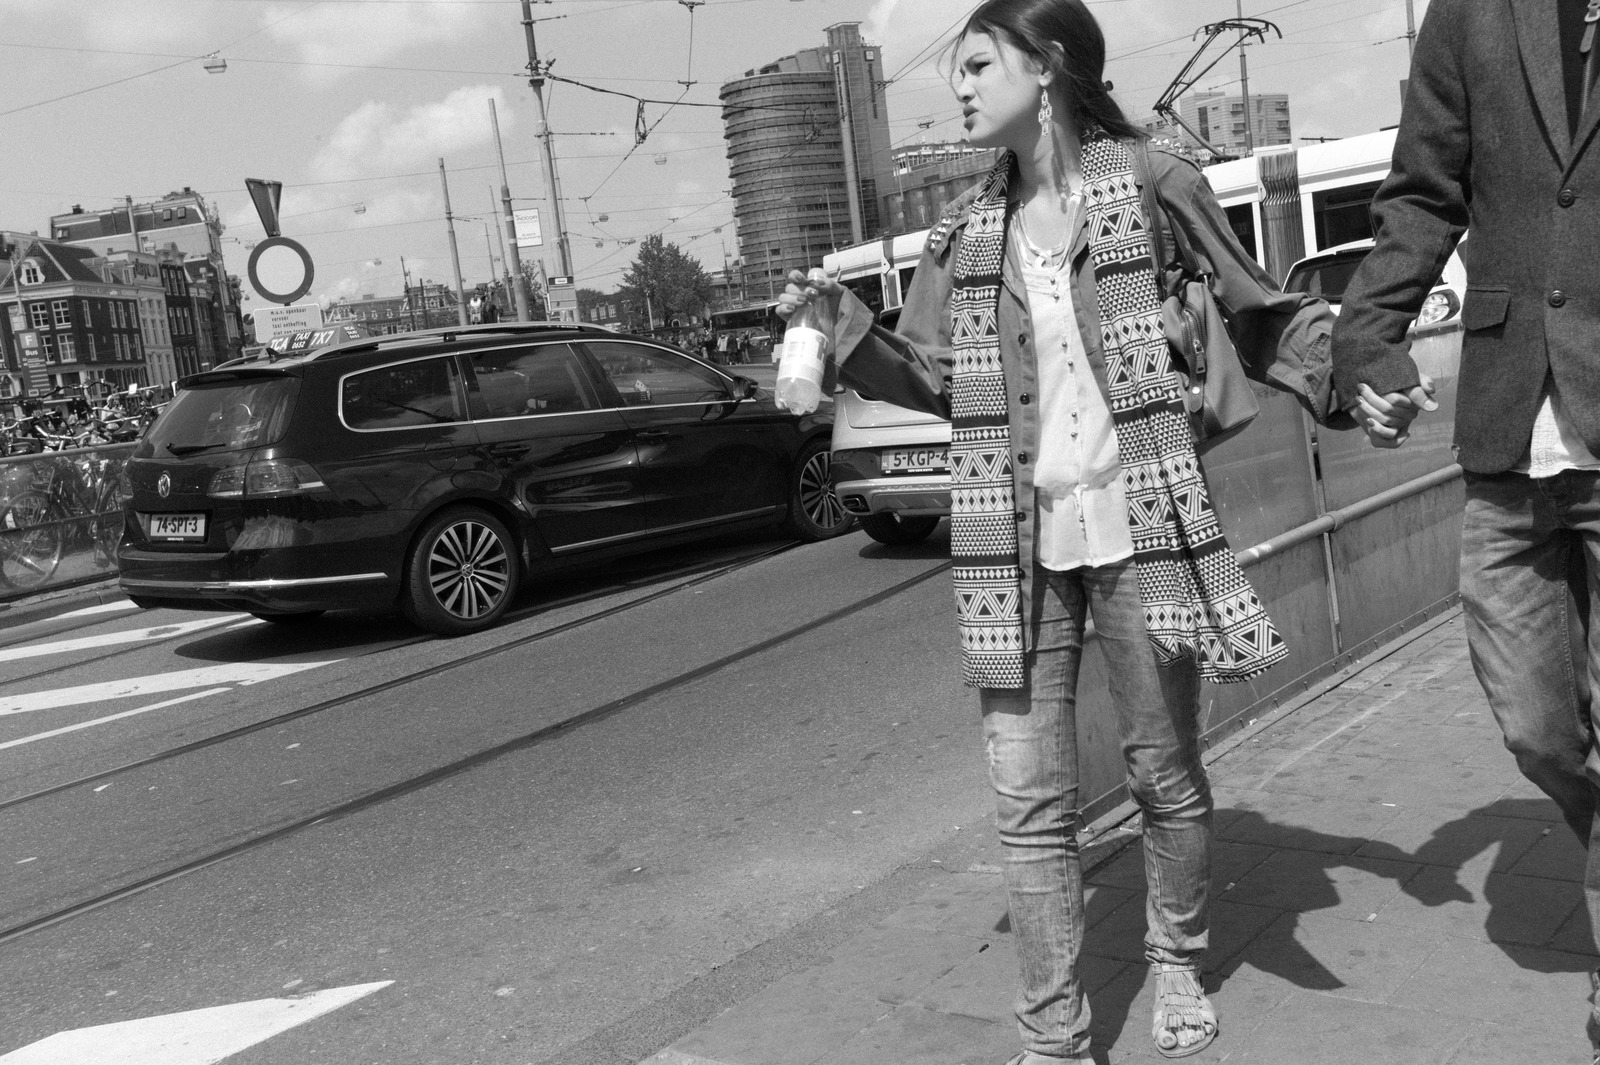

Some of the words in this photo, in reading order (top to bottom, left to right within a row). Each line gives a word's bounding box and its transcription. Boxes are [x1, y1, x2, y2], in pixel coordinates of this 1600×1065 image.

[25, 335, 32, 346] F
[294, 332, 312, 341] TAXI
[270, 337, 289, 351] TCA
[893, 449, 949, 467] 5-KGP-4
[156, 516, 198, 534] 74-SPT-3
